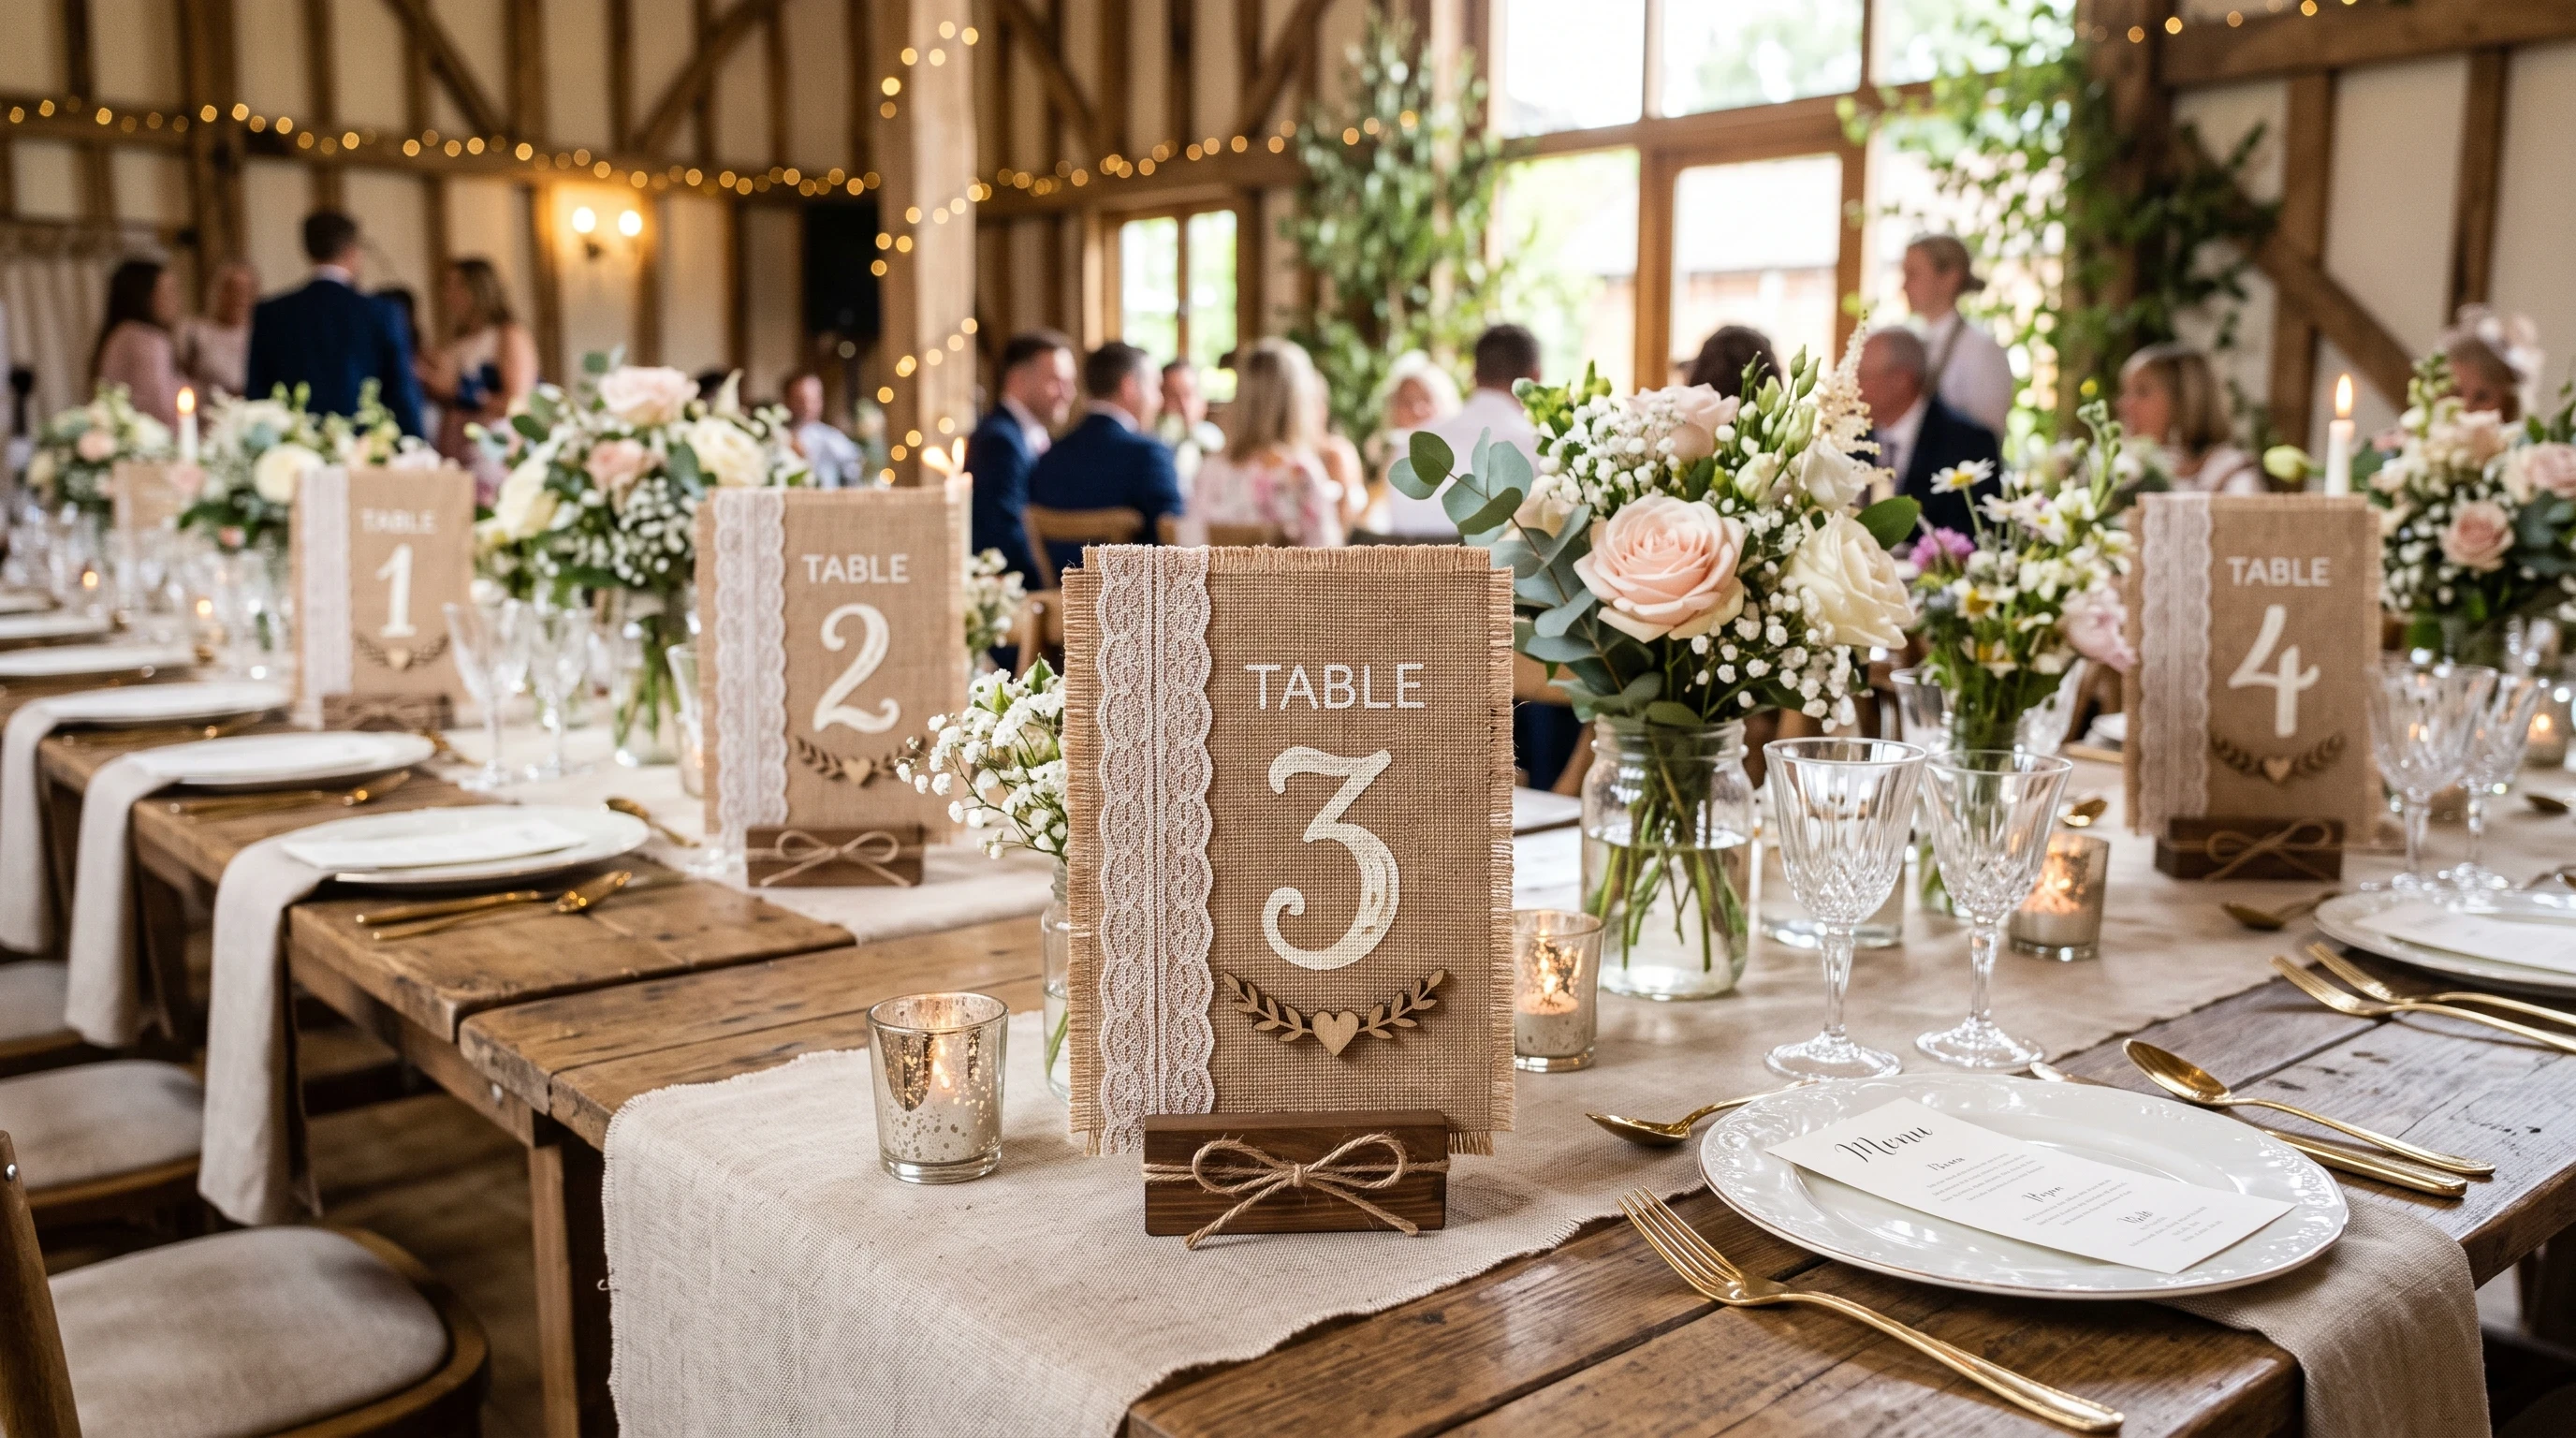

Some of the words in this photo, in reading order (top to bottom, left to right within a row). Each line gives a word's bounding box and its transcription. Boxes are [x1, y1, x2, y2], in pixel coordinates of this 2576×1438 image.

[361, 507, 437, 534] TABLE
[376, 544, 417, 638] 1
[802, 553, 911, 584] TABLE
[2228, 556, 2332, 587] TABLE
[812, 603, 901, 734] 2
[1245, 663, 1426, 711] TABLE
[2227, 604, 2320, 738] 4
[1261, 746, 1400, 971] 3
[1834, 1126, 1934, 1163] Menu
